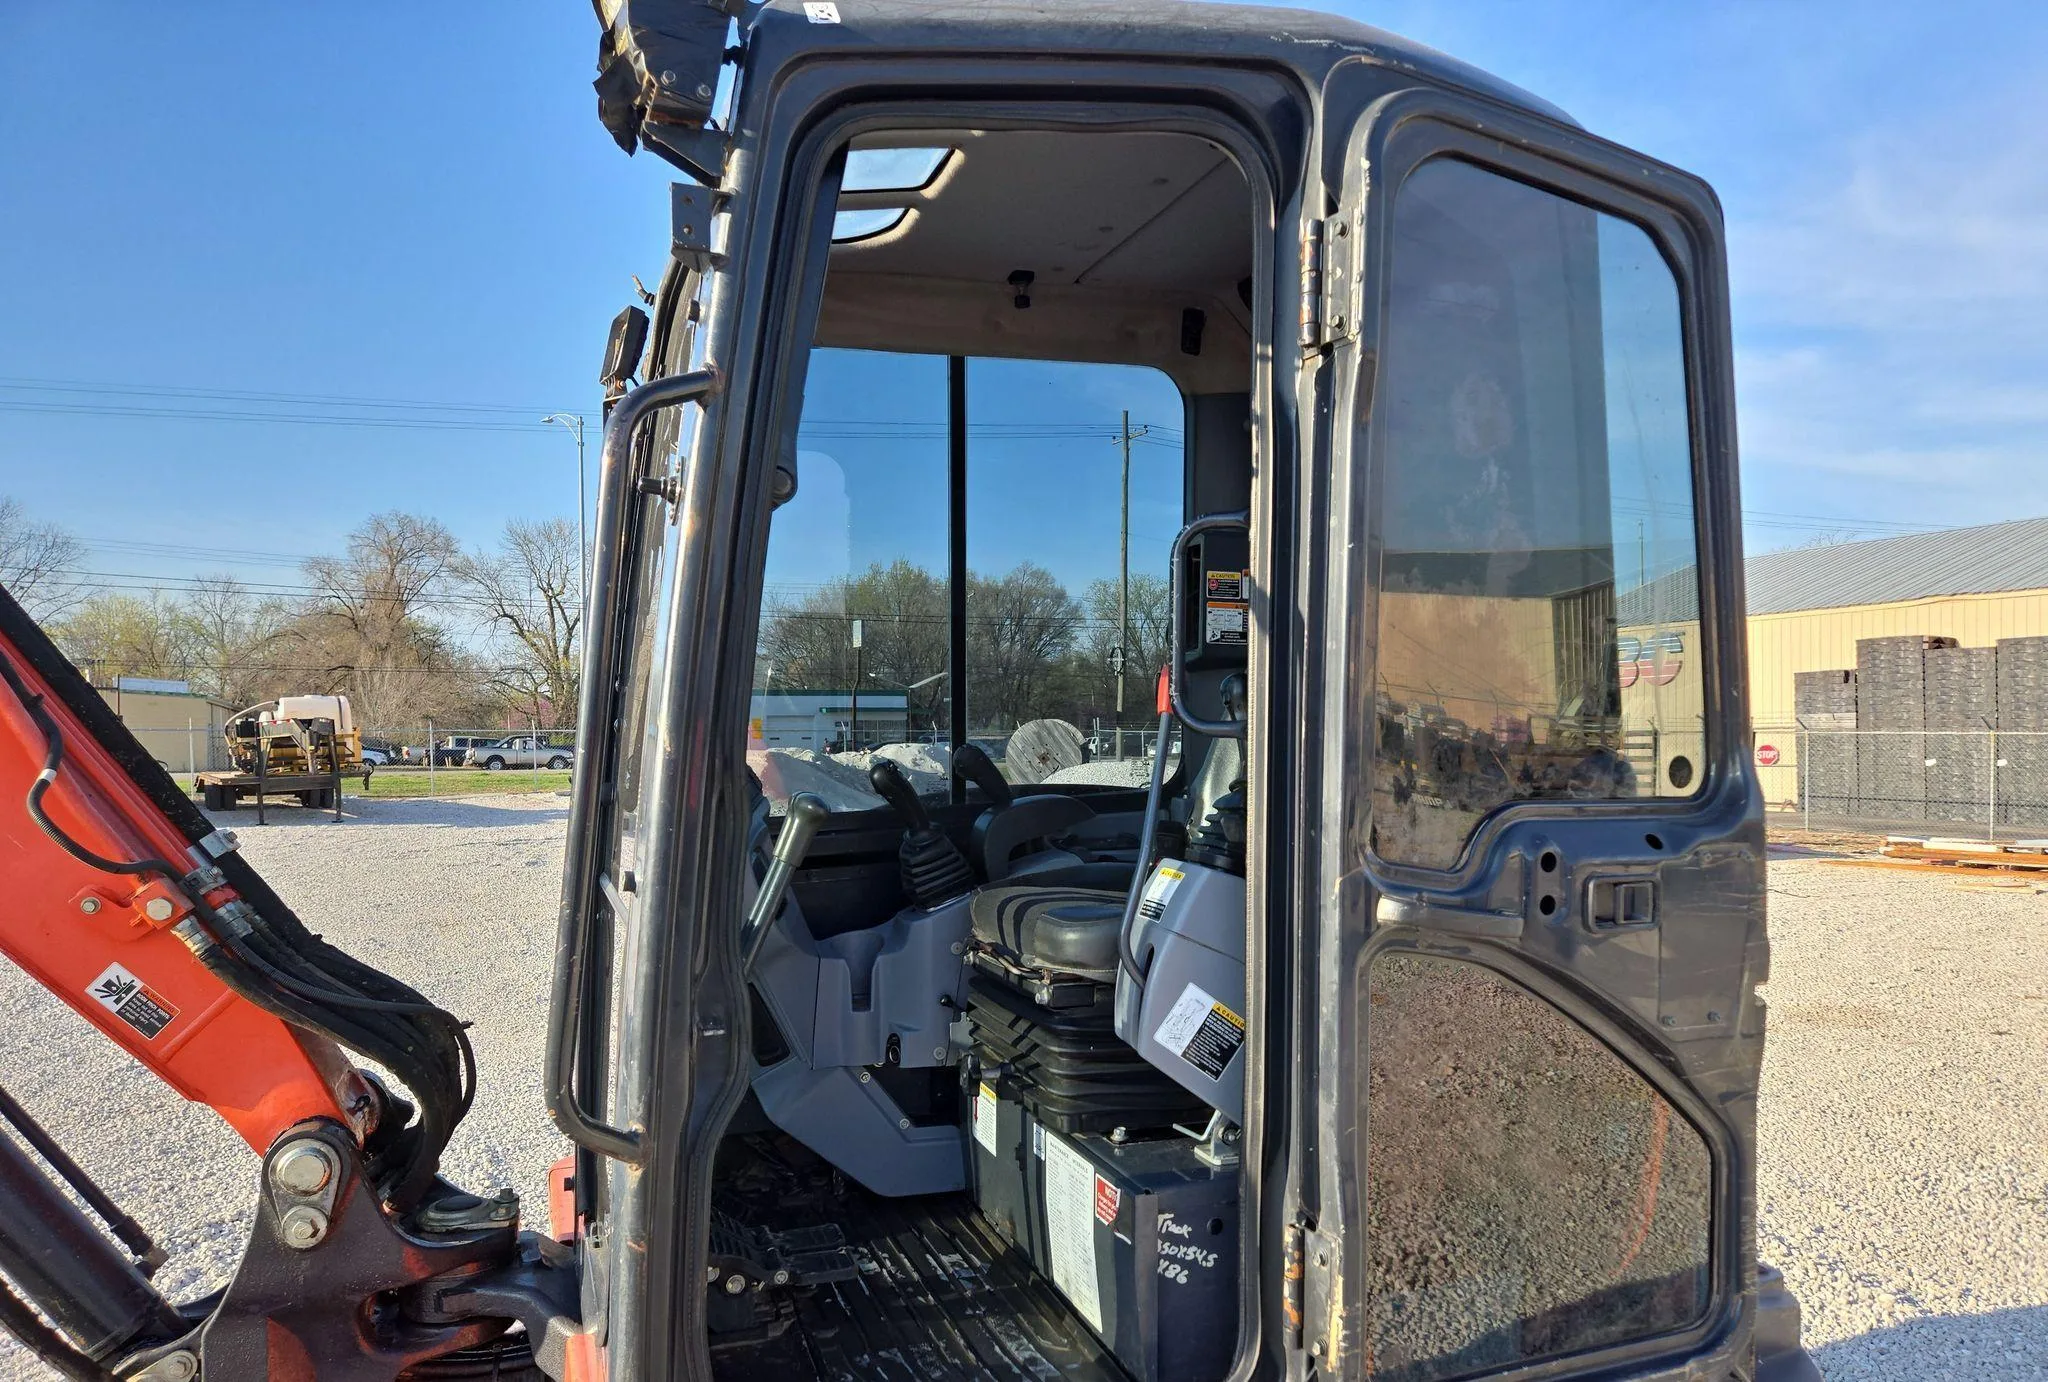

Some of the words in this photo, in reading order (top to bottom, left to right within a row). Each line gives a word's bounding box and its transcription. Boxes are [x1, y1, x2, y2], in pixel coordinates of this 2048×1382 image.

[1757, 751, 1776, 759] STOP
[148, 992, 175, 1012] WARNING
[1220, 1009, 1245, 1028] CAUTIO
